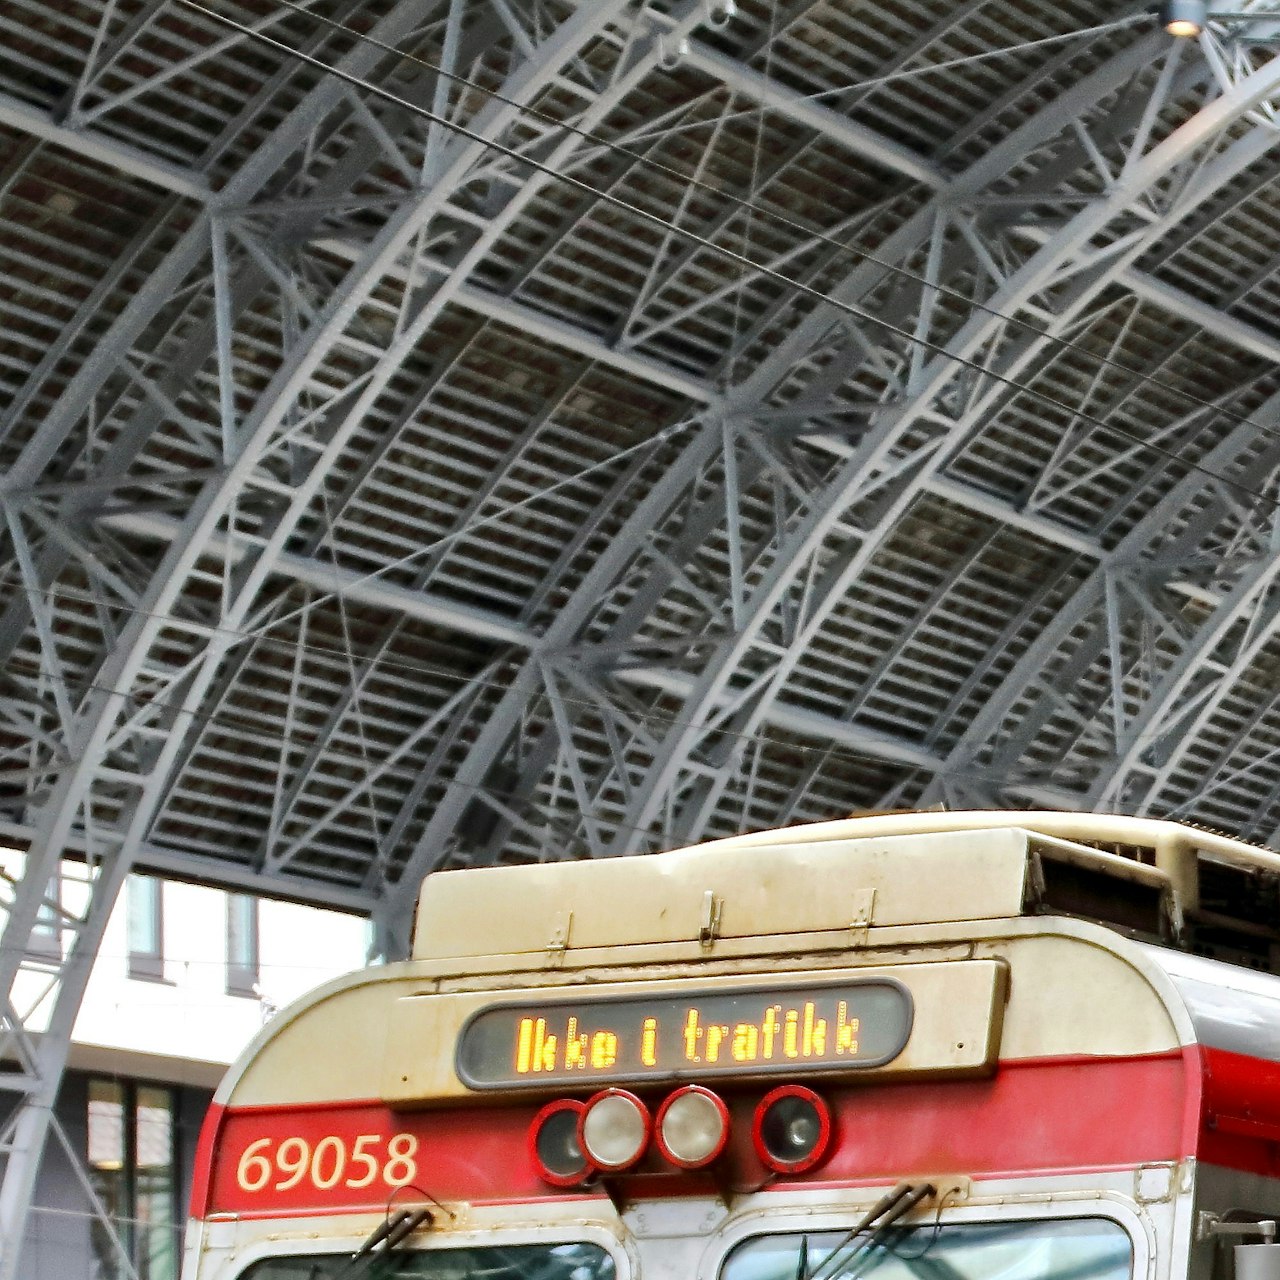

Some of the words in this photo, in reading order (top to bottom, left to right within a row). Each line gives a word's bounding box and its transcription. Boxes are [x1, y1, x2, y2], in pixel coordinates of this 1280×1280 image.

[517, 1016, 617, 1073] Ikke
[641, 1017, 658, 1067] i
[684, 1000, 861, 1064] trafikk
[236, 1133, 419, 1192] 69058
